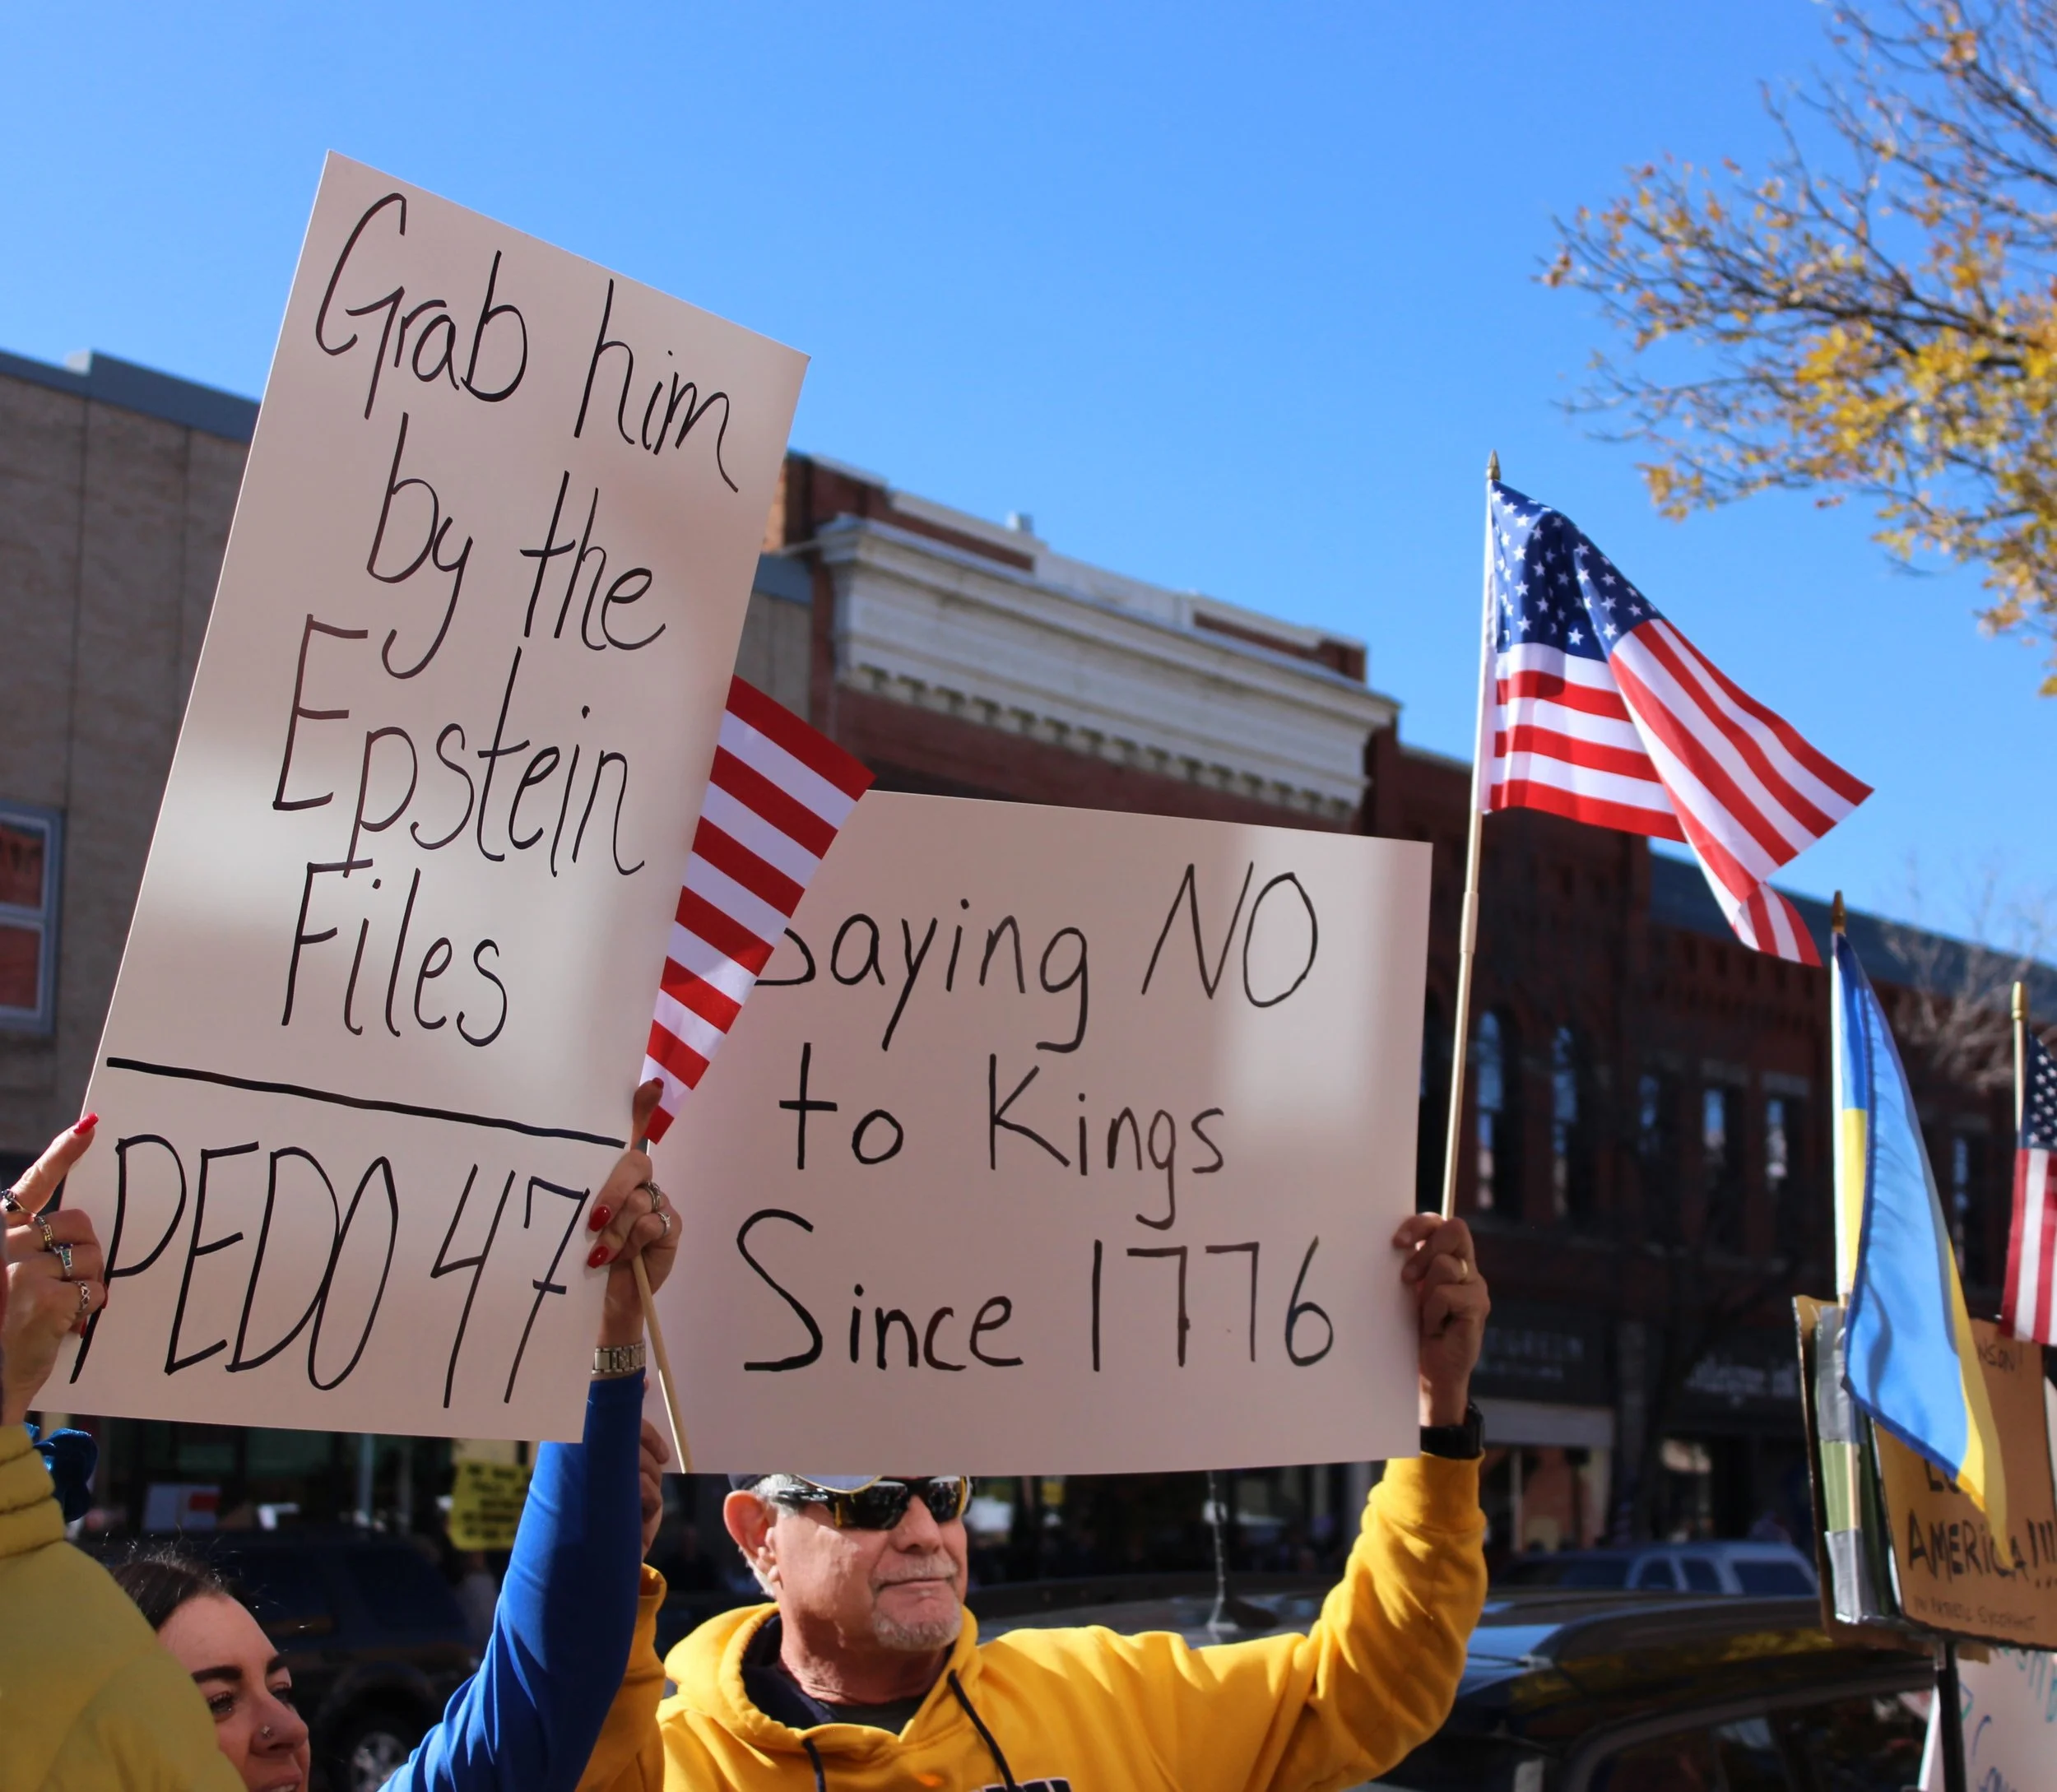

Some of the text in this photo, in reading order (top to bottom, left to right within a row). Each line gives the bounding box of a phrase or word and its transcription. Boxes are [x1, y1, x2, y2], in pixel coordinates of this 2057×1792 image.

[315, 193, 739, 494] Grab him
[365, 411, 666, 680] by the
[272, 612, 645, 877] Epstein
[281, 857, 508, 1047] Files
[1140, 861, 1318, 1008] NO
[778, 1042, 1225, 1231] to Kings
[68, 1134, 591, 1409] PEDO 47
[736, 1208, 1335, 1373] Since 1776
